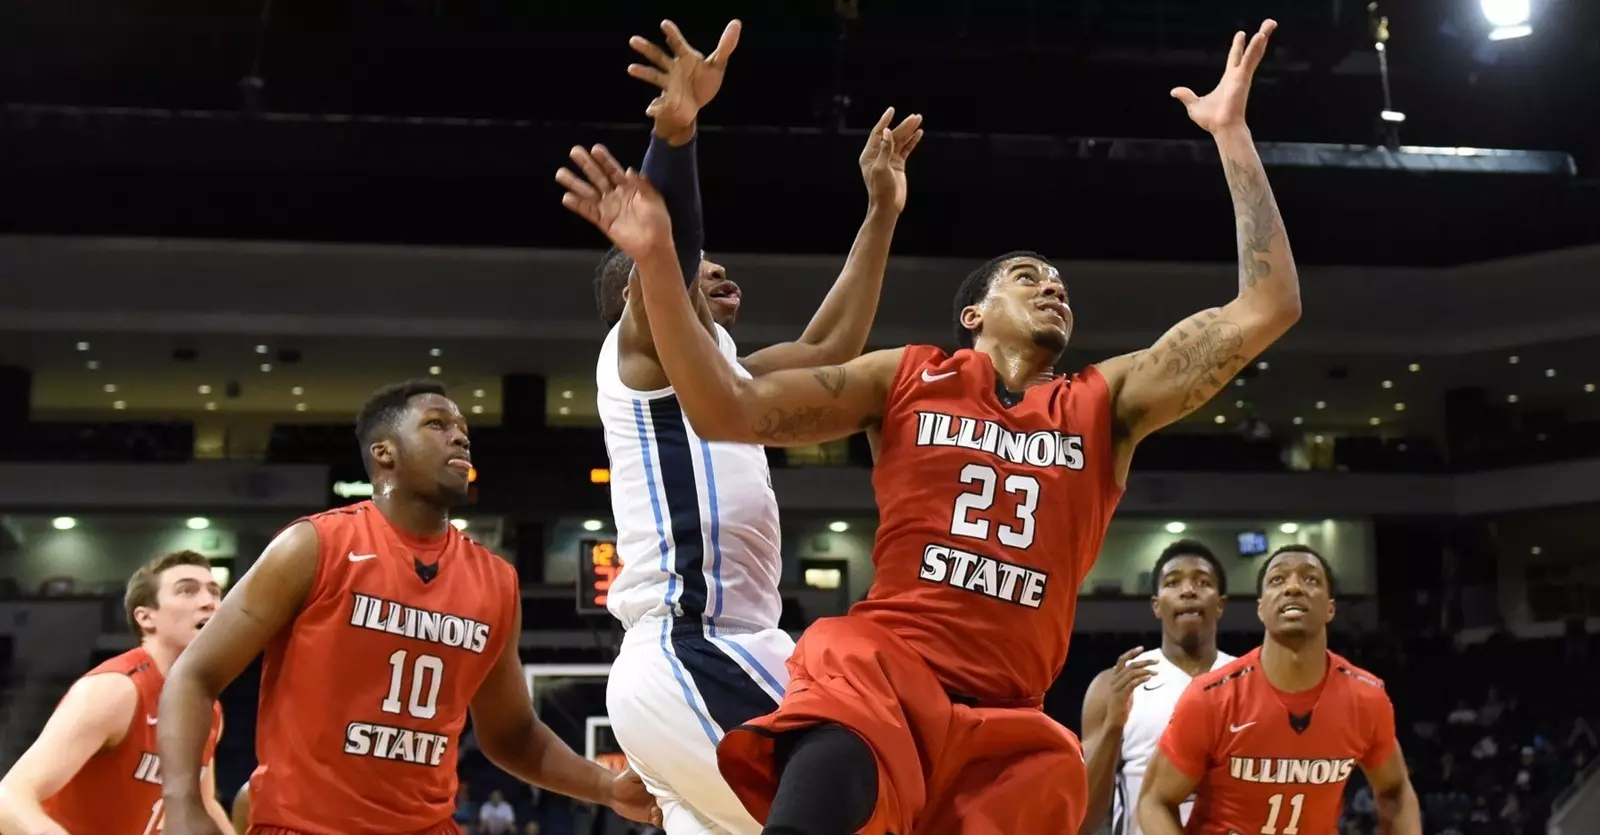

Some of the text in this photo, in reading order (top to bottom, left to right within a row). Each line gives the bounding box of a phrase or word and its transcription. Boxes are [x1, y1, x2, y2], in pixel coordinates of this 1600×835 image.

[915, 412, 1085, 470] ILLINOIS
[951, 463, 1040, 550] 23
[919, 543, 1047, 608] STATE
[350, 593, 490, 654] ILLINOIS
[382, 649, 444, 719] 10
[344, 722, 449, 766] STATE
[1230, 756, 1356, 785] ILLINOIS
[1260, 793, 1305, 835] 11
